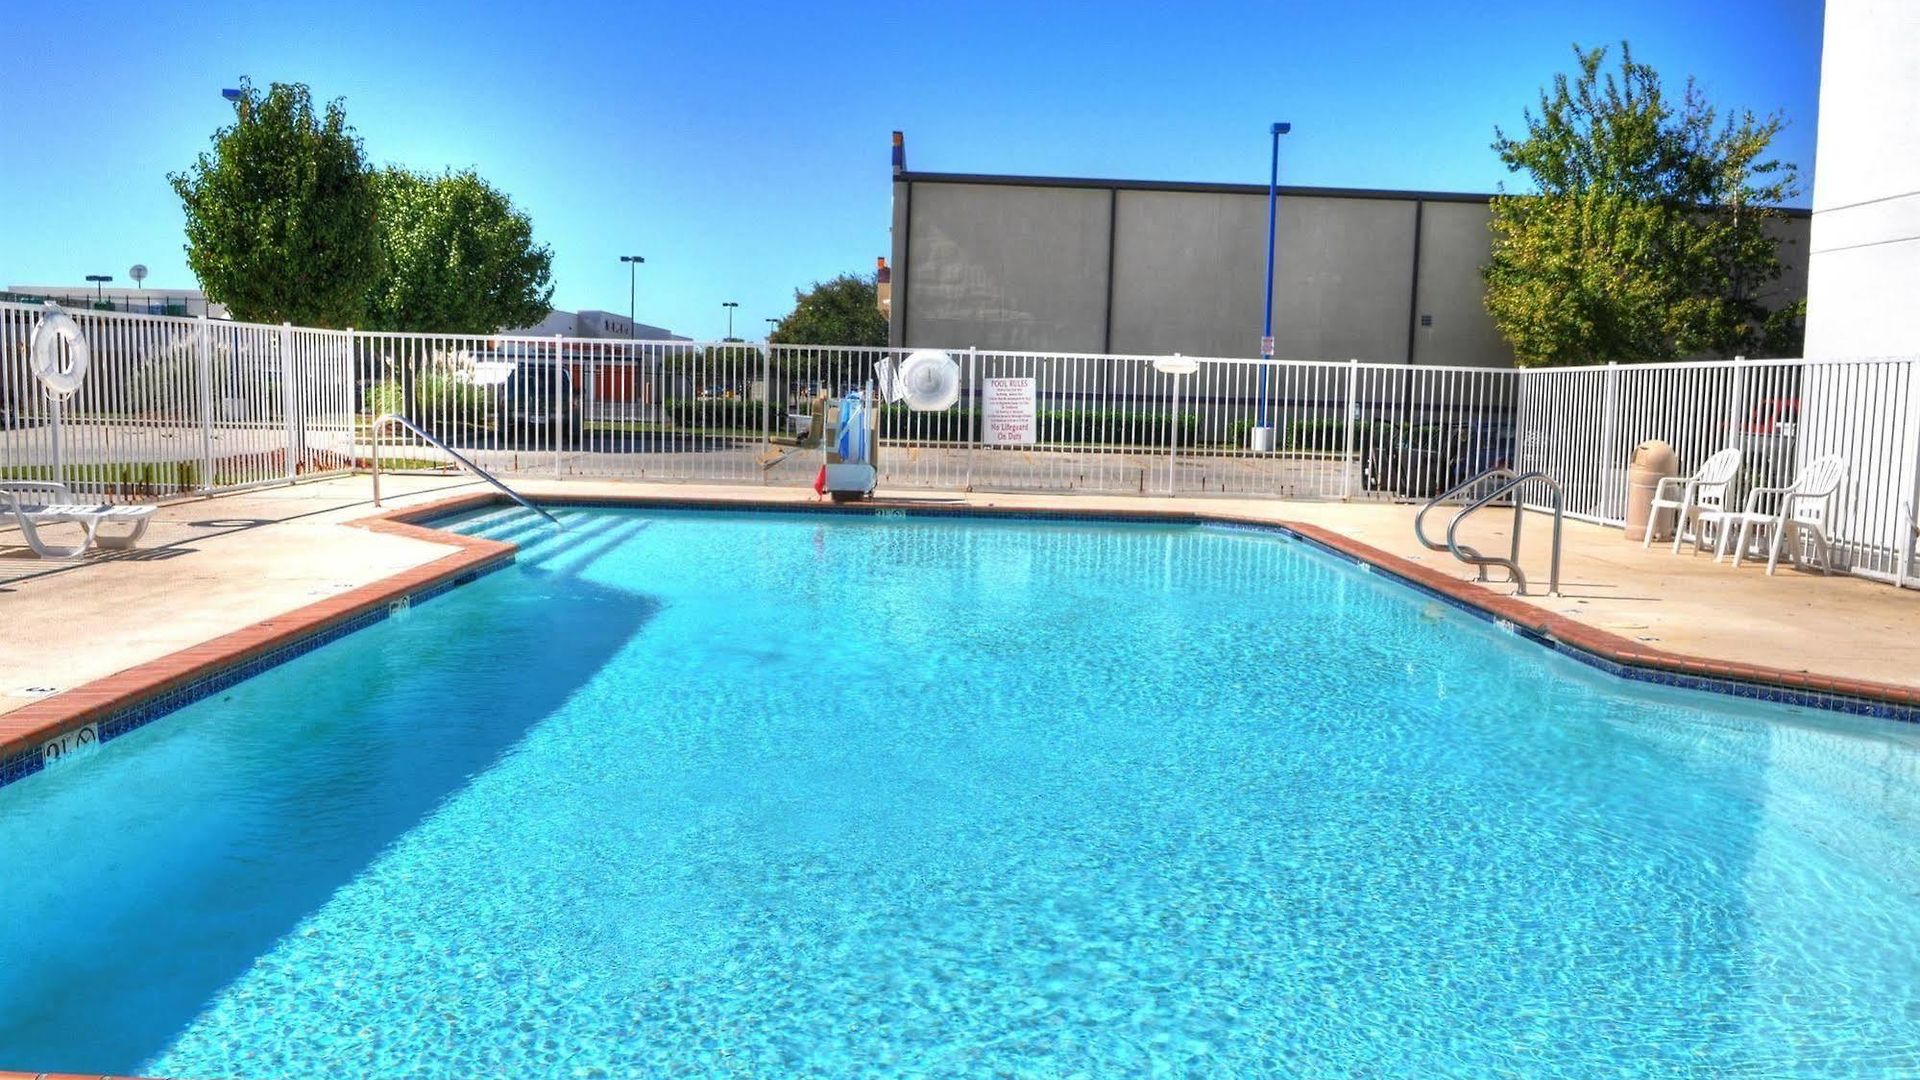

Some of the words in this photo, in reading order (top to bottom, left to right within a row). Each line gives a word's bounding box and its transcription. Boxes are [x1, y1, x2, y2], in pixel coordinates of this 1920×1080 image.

[1001, 423, 1029, 432] Lifeguard
[997, 432, 1007, 440] On
[1008, 432, 1022, 441] Duty
